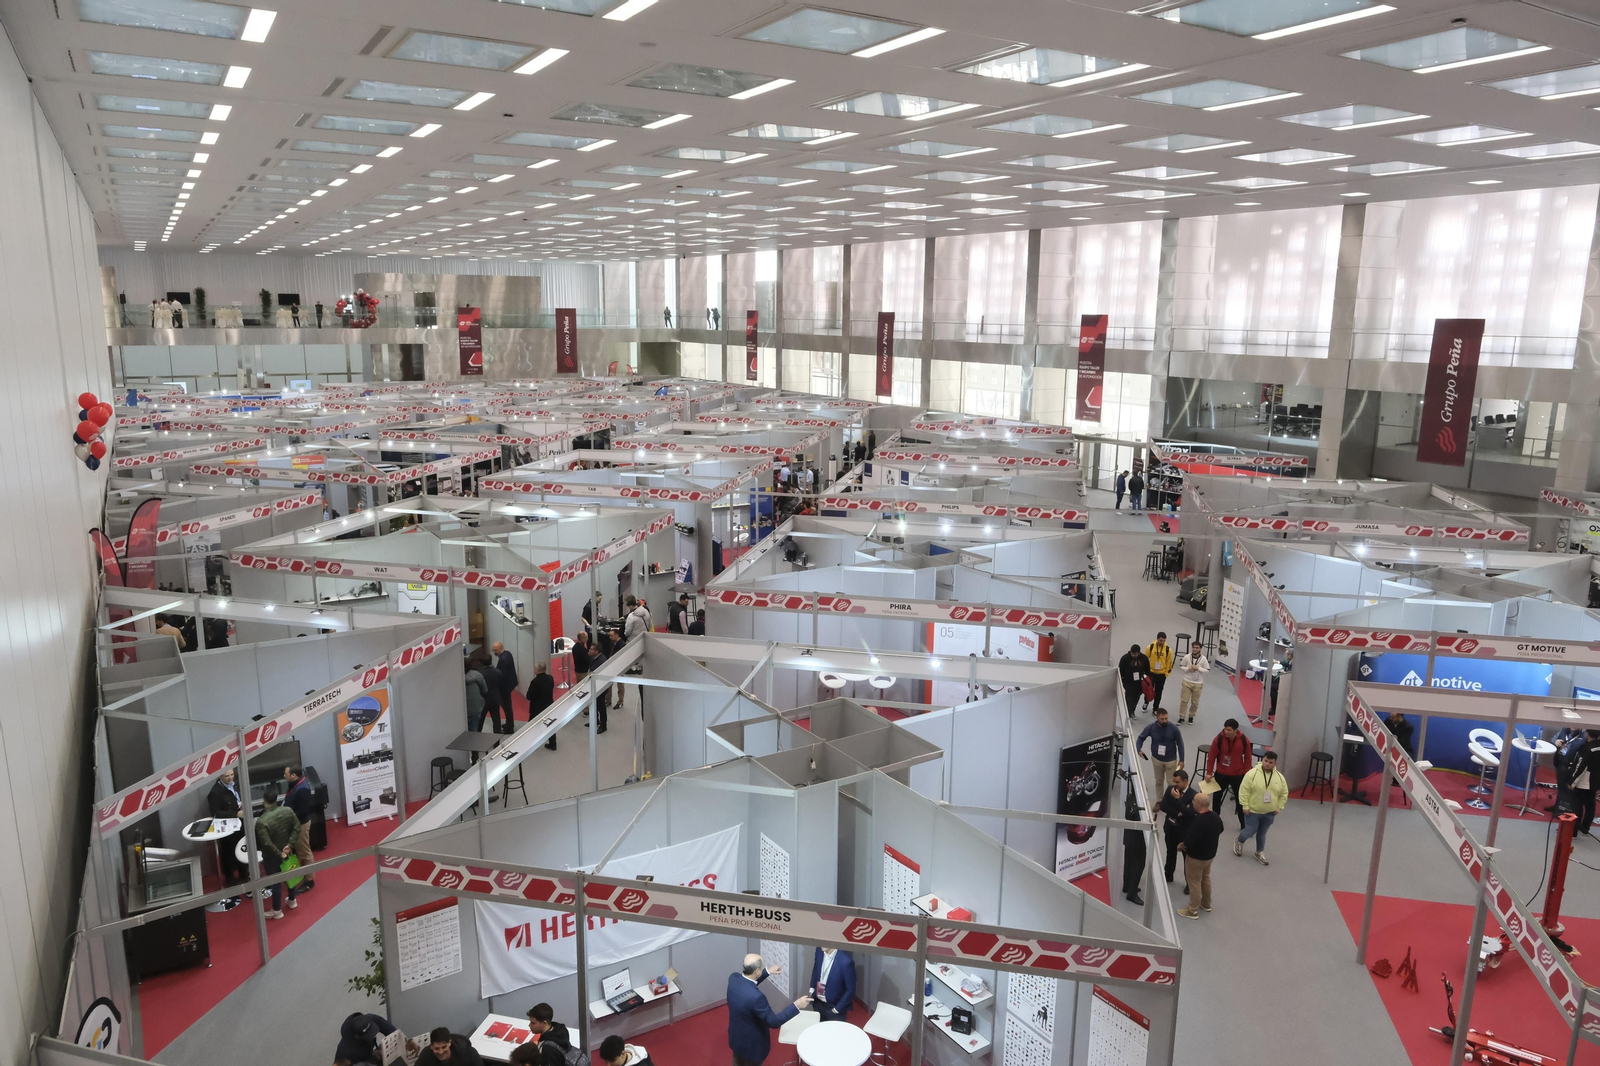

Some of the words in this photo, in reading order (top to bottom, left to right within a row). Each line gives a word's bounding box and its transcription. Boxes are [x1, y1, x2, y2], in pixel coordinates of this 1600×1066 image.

[563, 333, 572, 355] Grupo
[881, 346, 889, 373] Grupo
[1446, 337, 1463, 378] Peña
[1441, 379, 1459, 423] Grupo
[185, 544, 212, 553] FAST
[889, 602, 912, 612] PHIRA
[940, 626, 955, 639] 05
[1517, 643, 1530, 652] GT
[1530, 644, 1567, 654] MOTIVE
[1531, 652, 1564, 660] PROFESIONAL
[303, 687, 342, 714] TIERRATECH
[1088, 740, 1110, 750] HITACHI
[1425, 793, 1440, 817] ASTRA
[1058, 855, 1078, 865] HITACHI
[700, 901, 791, 923] HERTH+BUSS
[709, 914, 728, 926] PEÑA
[730, 917, 782, 931] PROFESIONAL
